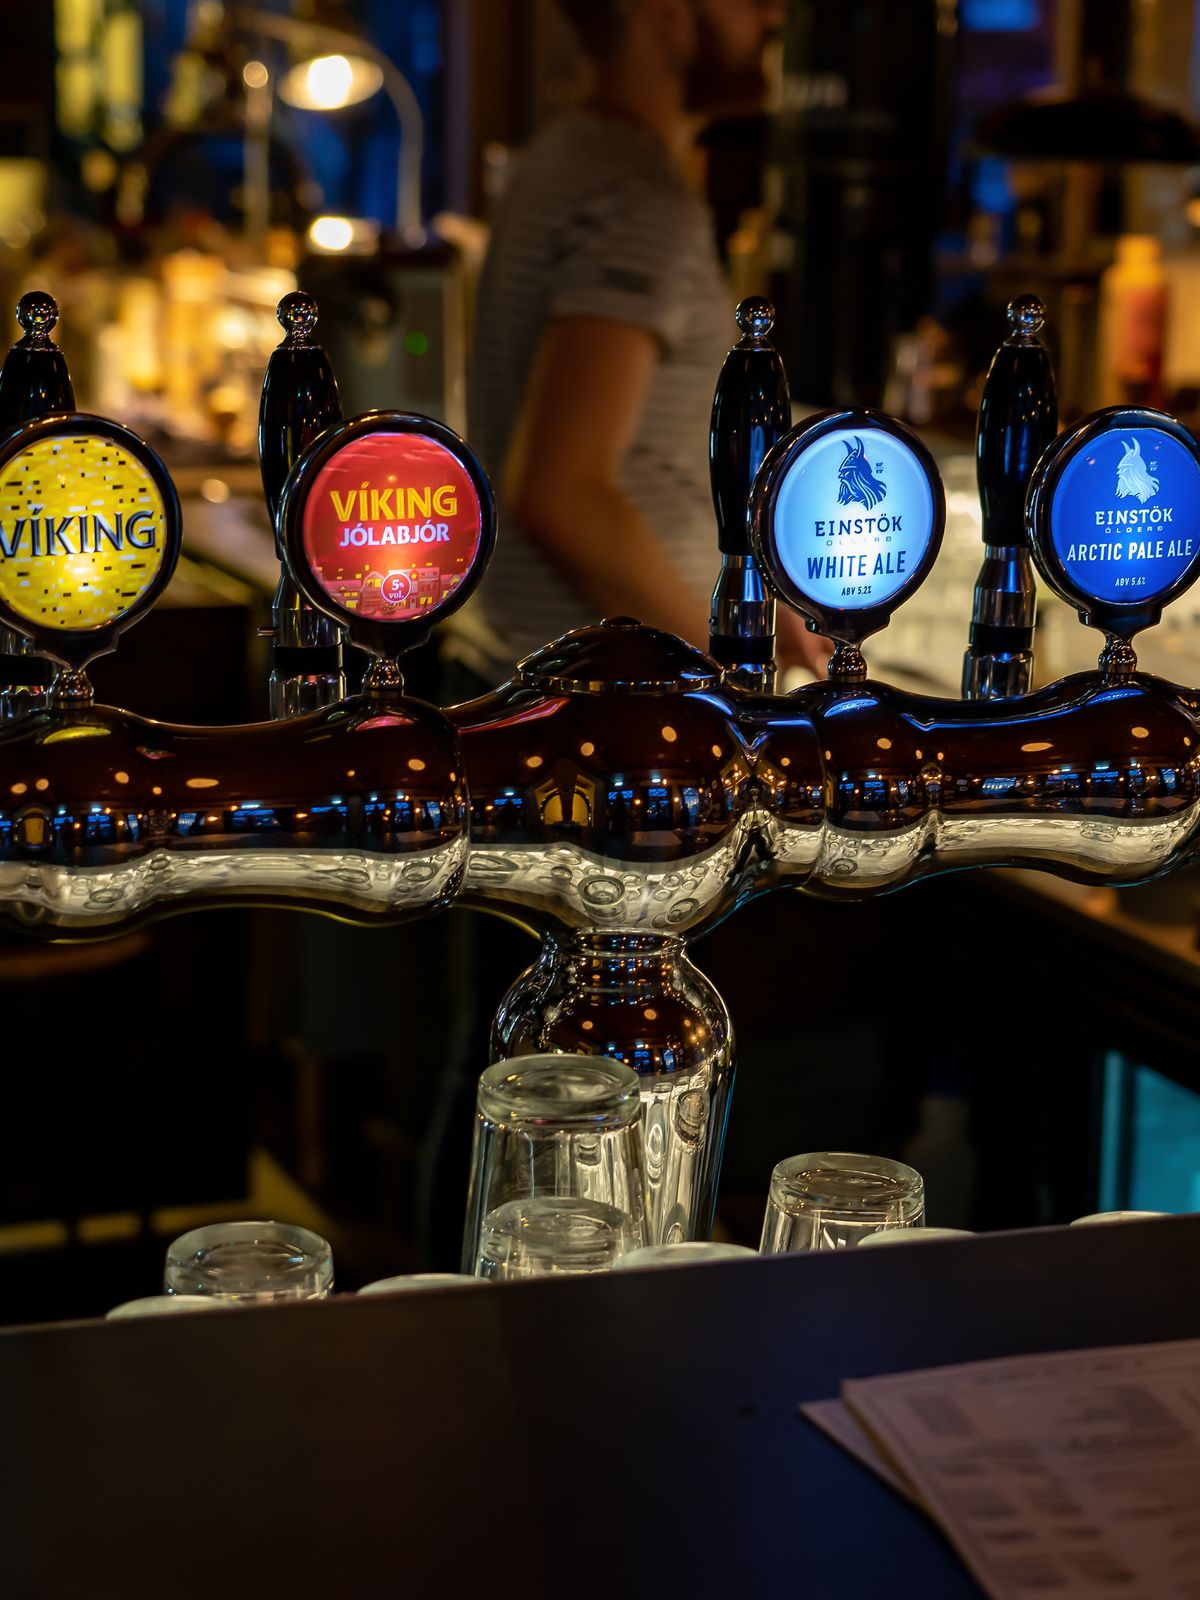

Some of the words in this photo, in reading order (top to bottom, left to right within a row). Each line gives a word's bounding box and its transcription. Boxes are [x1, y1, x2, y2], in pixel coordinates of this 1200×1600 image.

[330, 481, 458, 522] VÍKING
[814, 513, 903, 537] EINSTÖK
[1095, 505, 1173, 526] EINSTÖK
[0, 504, 157, 558] VÍKING
[339, 519, 450, 547] JÓLABJÓR
[1067, 542, 1123, 562] ARCTIC
[1128, 540, 1164, 560] PALE
[1167, 538, 1193, 558] ALE
[807, 554, 868, 580] WHITE
[873, 550, 907, 576] ALE
[841, 586, 856, 597] ABV
[1114, 577, 1130, 587] ABV
